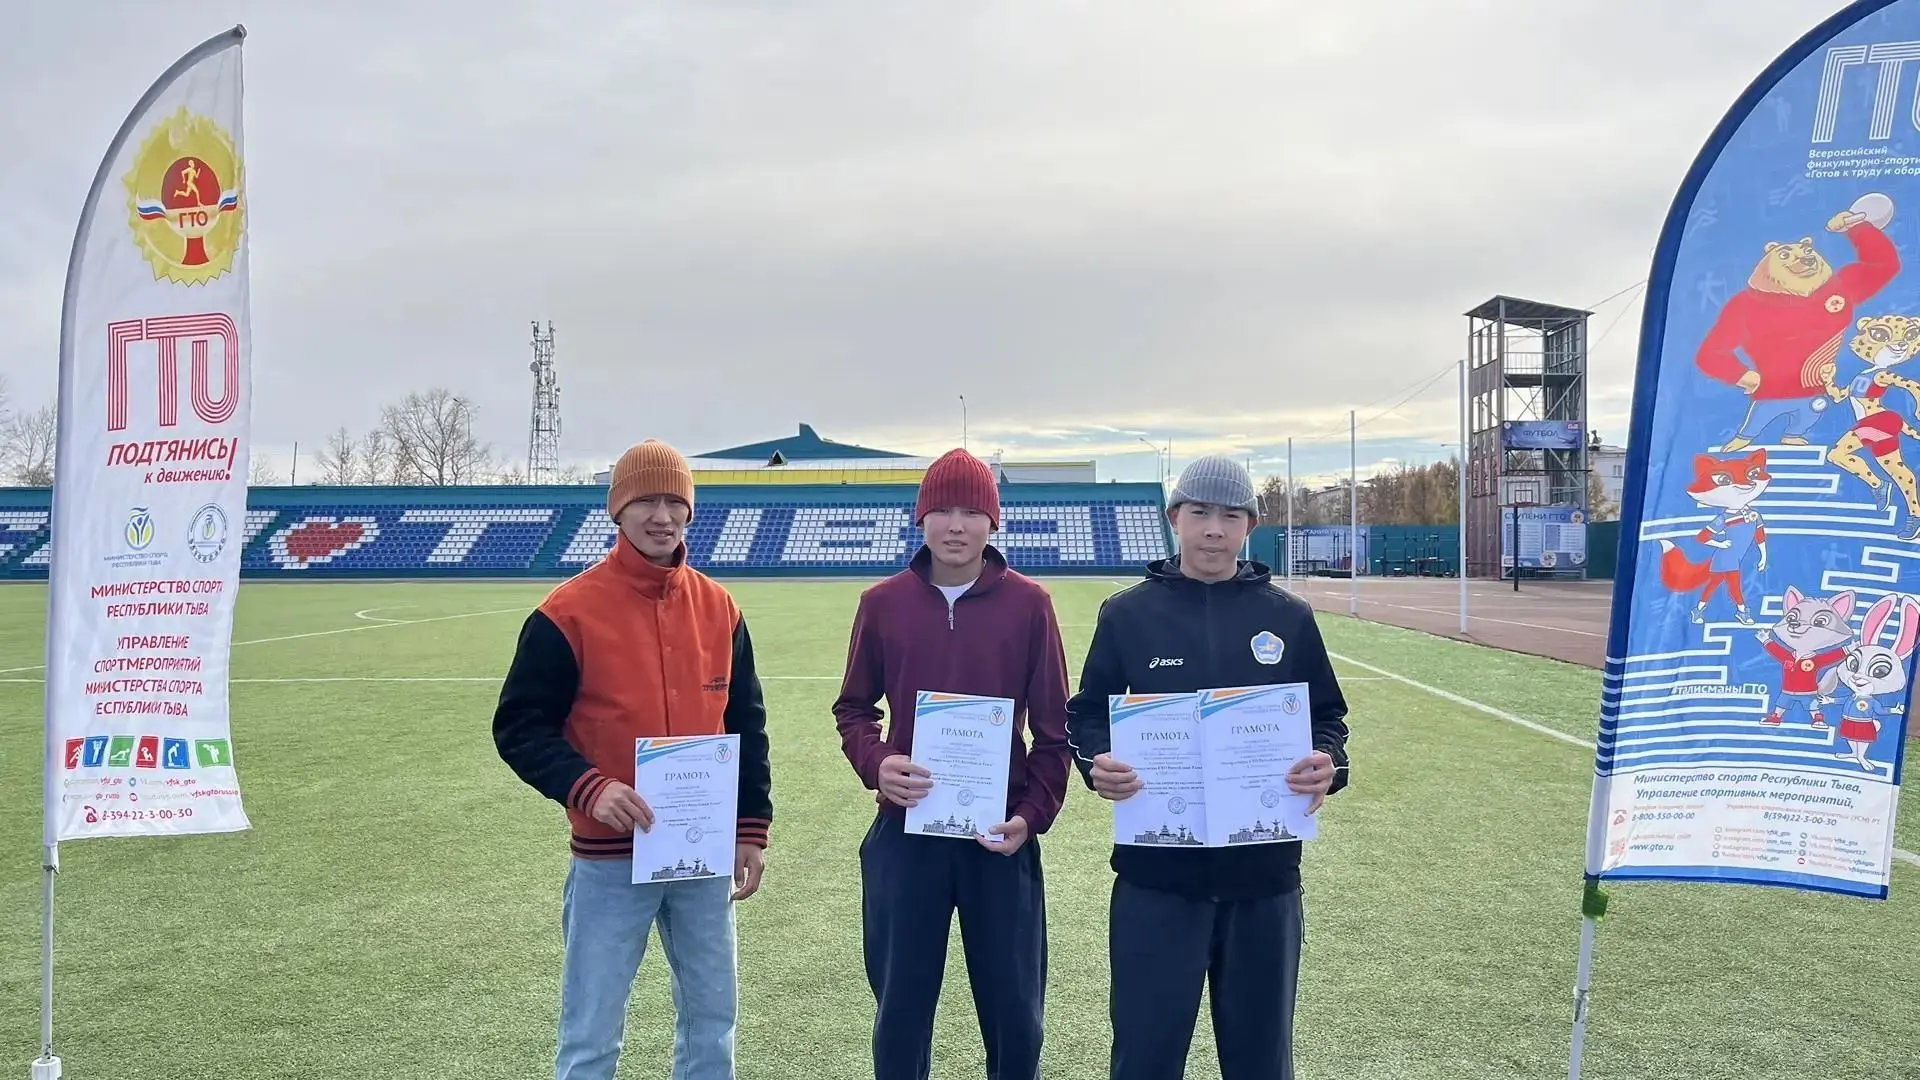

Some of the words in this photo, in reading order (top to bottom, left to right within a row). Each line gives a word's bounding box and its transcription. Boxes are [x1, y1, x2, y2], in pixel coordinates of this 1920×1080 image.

[1809, 146, 1887, 159] Всероссийский
[1851, 168, 1881, 178] труду
[178, 210, 208, 229] ГТО
[107, 312, 239, 431] ГТО
[144, 472, 153, 483] к
[91, 580, 190, 599] МИНИСТЕРСТВО
[192, 580, 223, 593] СПОРТ
[107, 602, 184, 618] РЕСПУБЛИКИ
[186, 602, 208, 615] ТЫВА
[117, 635, 189, 650] УПРАВЛЕНИЕ
[94, 656, 201, 673] СПОРТМЕРОПРИЯТИЙ
[1159, 657, 1184, 666] asics
[168, 679, 203, 695] СПОРТА
[163, 702, 188, 717] ТЫВА
[941, 727, 984, 739] ГРАМОТА
[1141, 732, 1190, 741] ГРАМОТА
[1231, 724, 1280, 735] ГРАМОТА
[664, 771, 710, 781] ГРАМОТА
[1634, 773, 1715, 784] Министерство
[1718, 773, 1758, 784] спорта
[1760, 773, 1827, 788] Республики
[1831, 779, 1862, 794] Тыва,
[1636, 788, 1698, 800] Управление
[1700, 788, 1767, 798] спортивных
[1769, 791, 1854, 809] мероприятий,
[1763, 811, 1837, 826] 8(394)22-3-00-30
